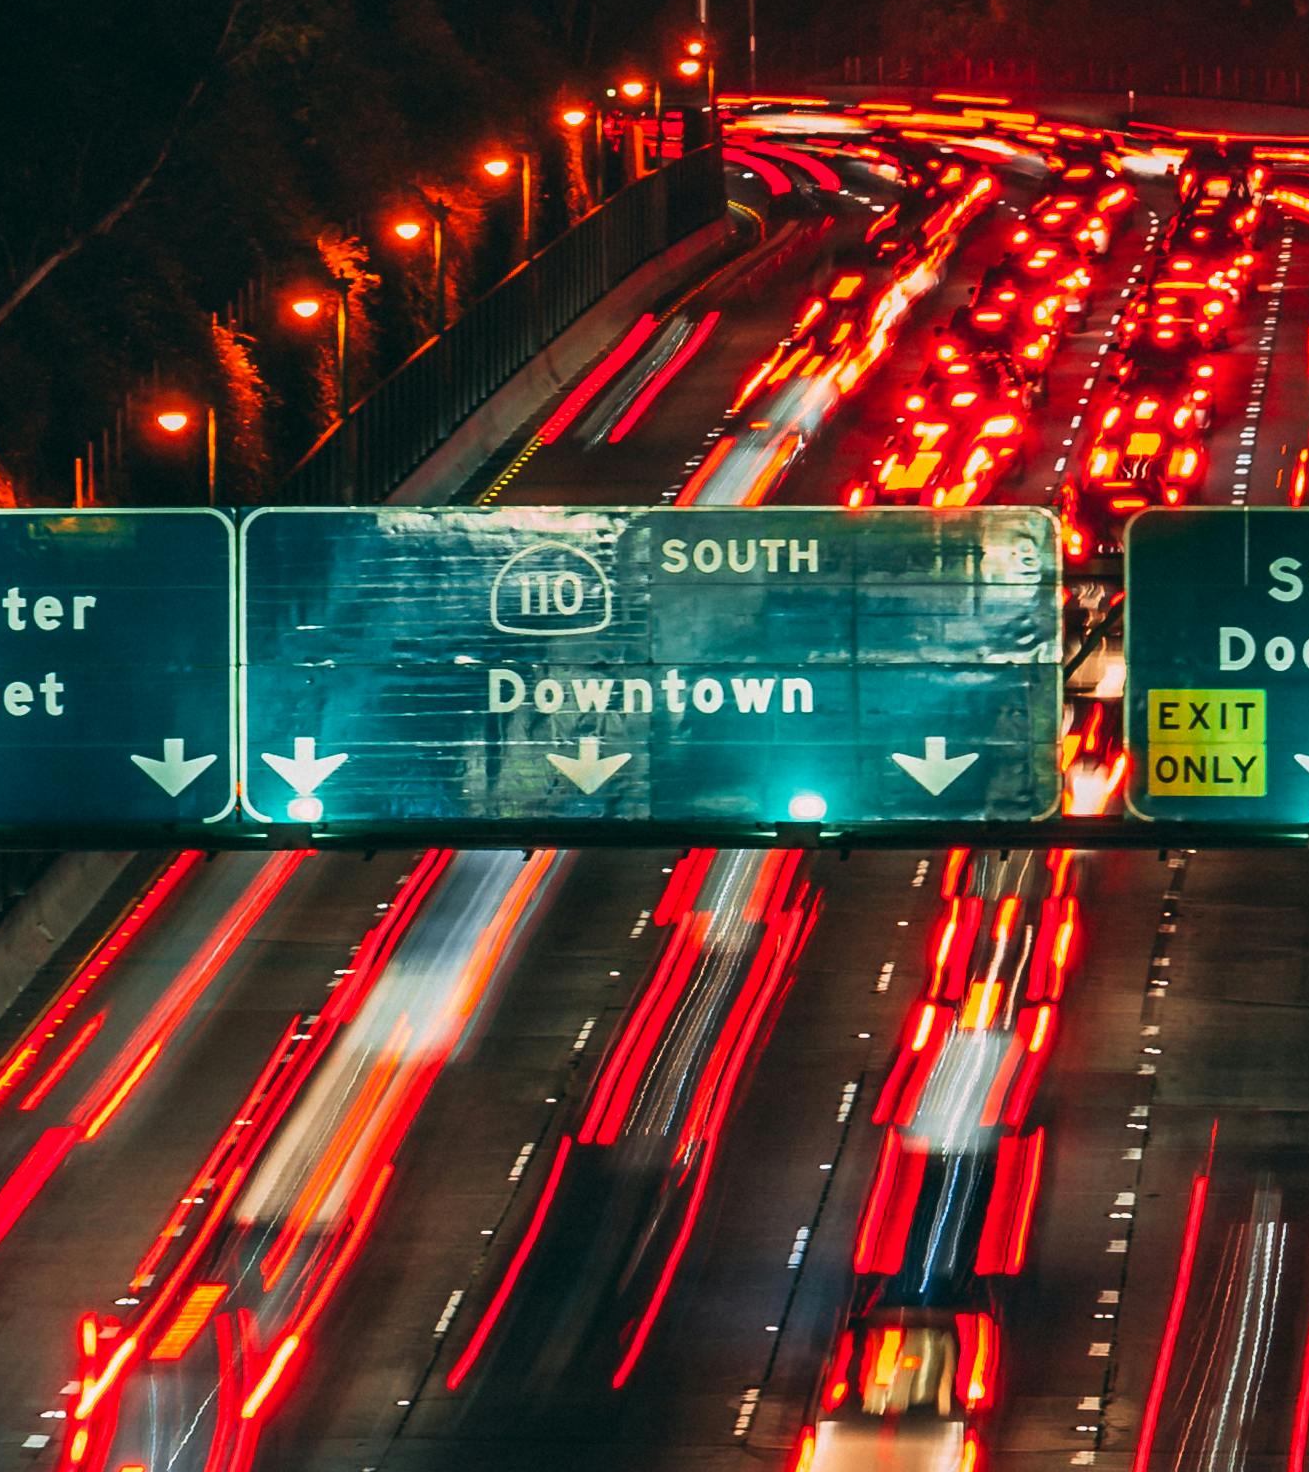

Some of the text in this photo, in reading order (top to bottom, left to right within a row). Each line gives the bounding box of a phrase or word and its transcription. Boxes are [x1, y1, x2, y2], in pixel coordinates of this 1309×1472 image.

[661, 539, 819, 573] SOUTH
[519, 571, 585, 617] 110
[489, 668, 814, 714] Downtown
[1158, 702, 1256, 731] EXIT
[1155, 755, 1257, 784] ONLY
